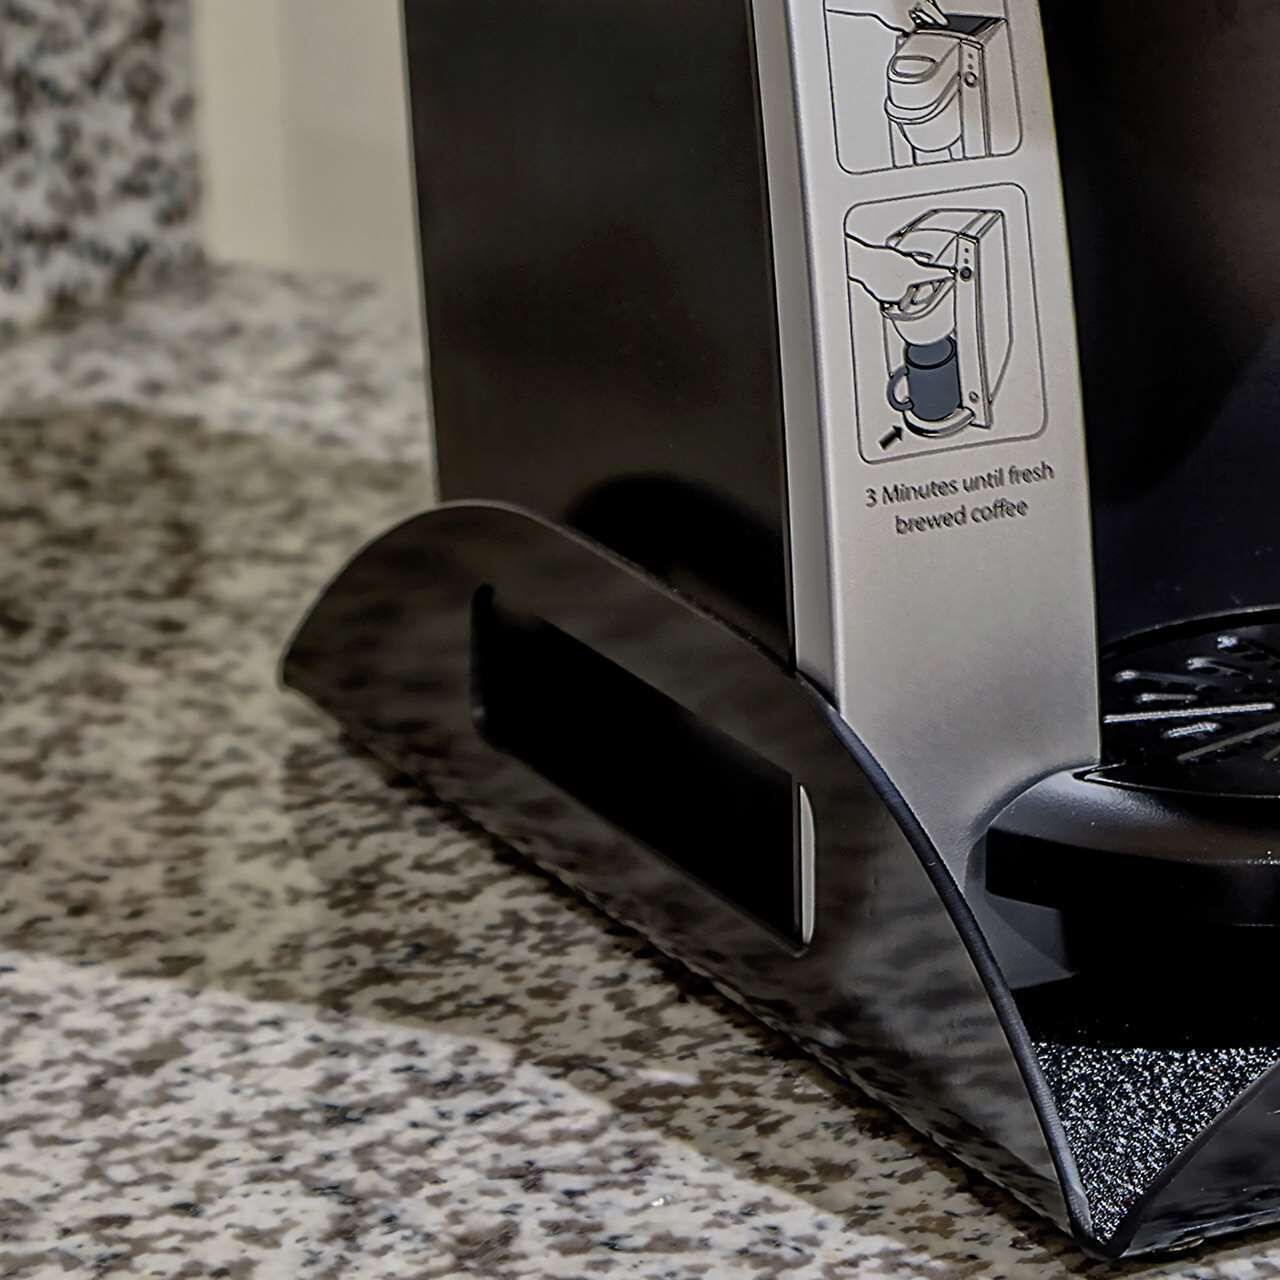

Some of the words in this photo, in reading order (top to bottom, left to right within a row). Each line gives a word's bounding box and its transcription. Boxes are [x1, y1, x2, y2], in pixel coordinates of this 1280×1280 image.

[865, 488, 878, 509] 3
[882, 478, 960, 506] Minutes
[963, 468, 1005, 494] until
[1008, 460, 1056, 485] fresh
[895, 504, 967, 536] brewed
[971, 497, 1029, 524] coffee
